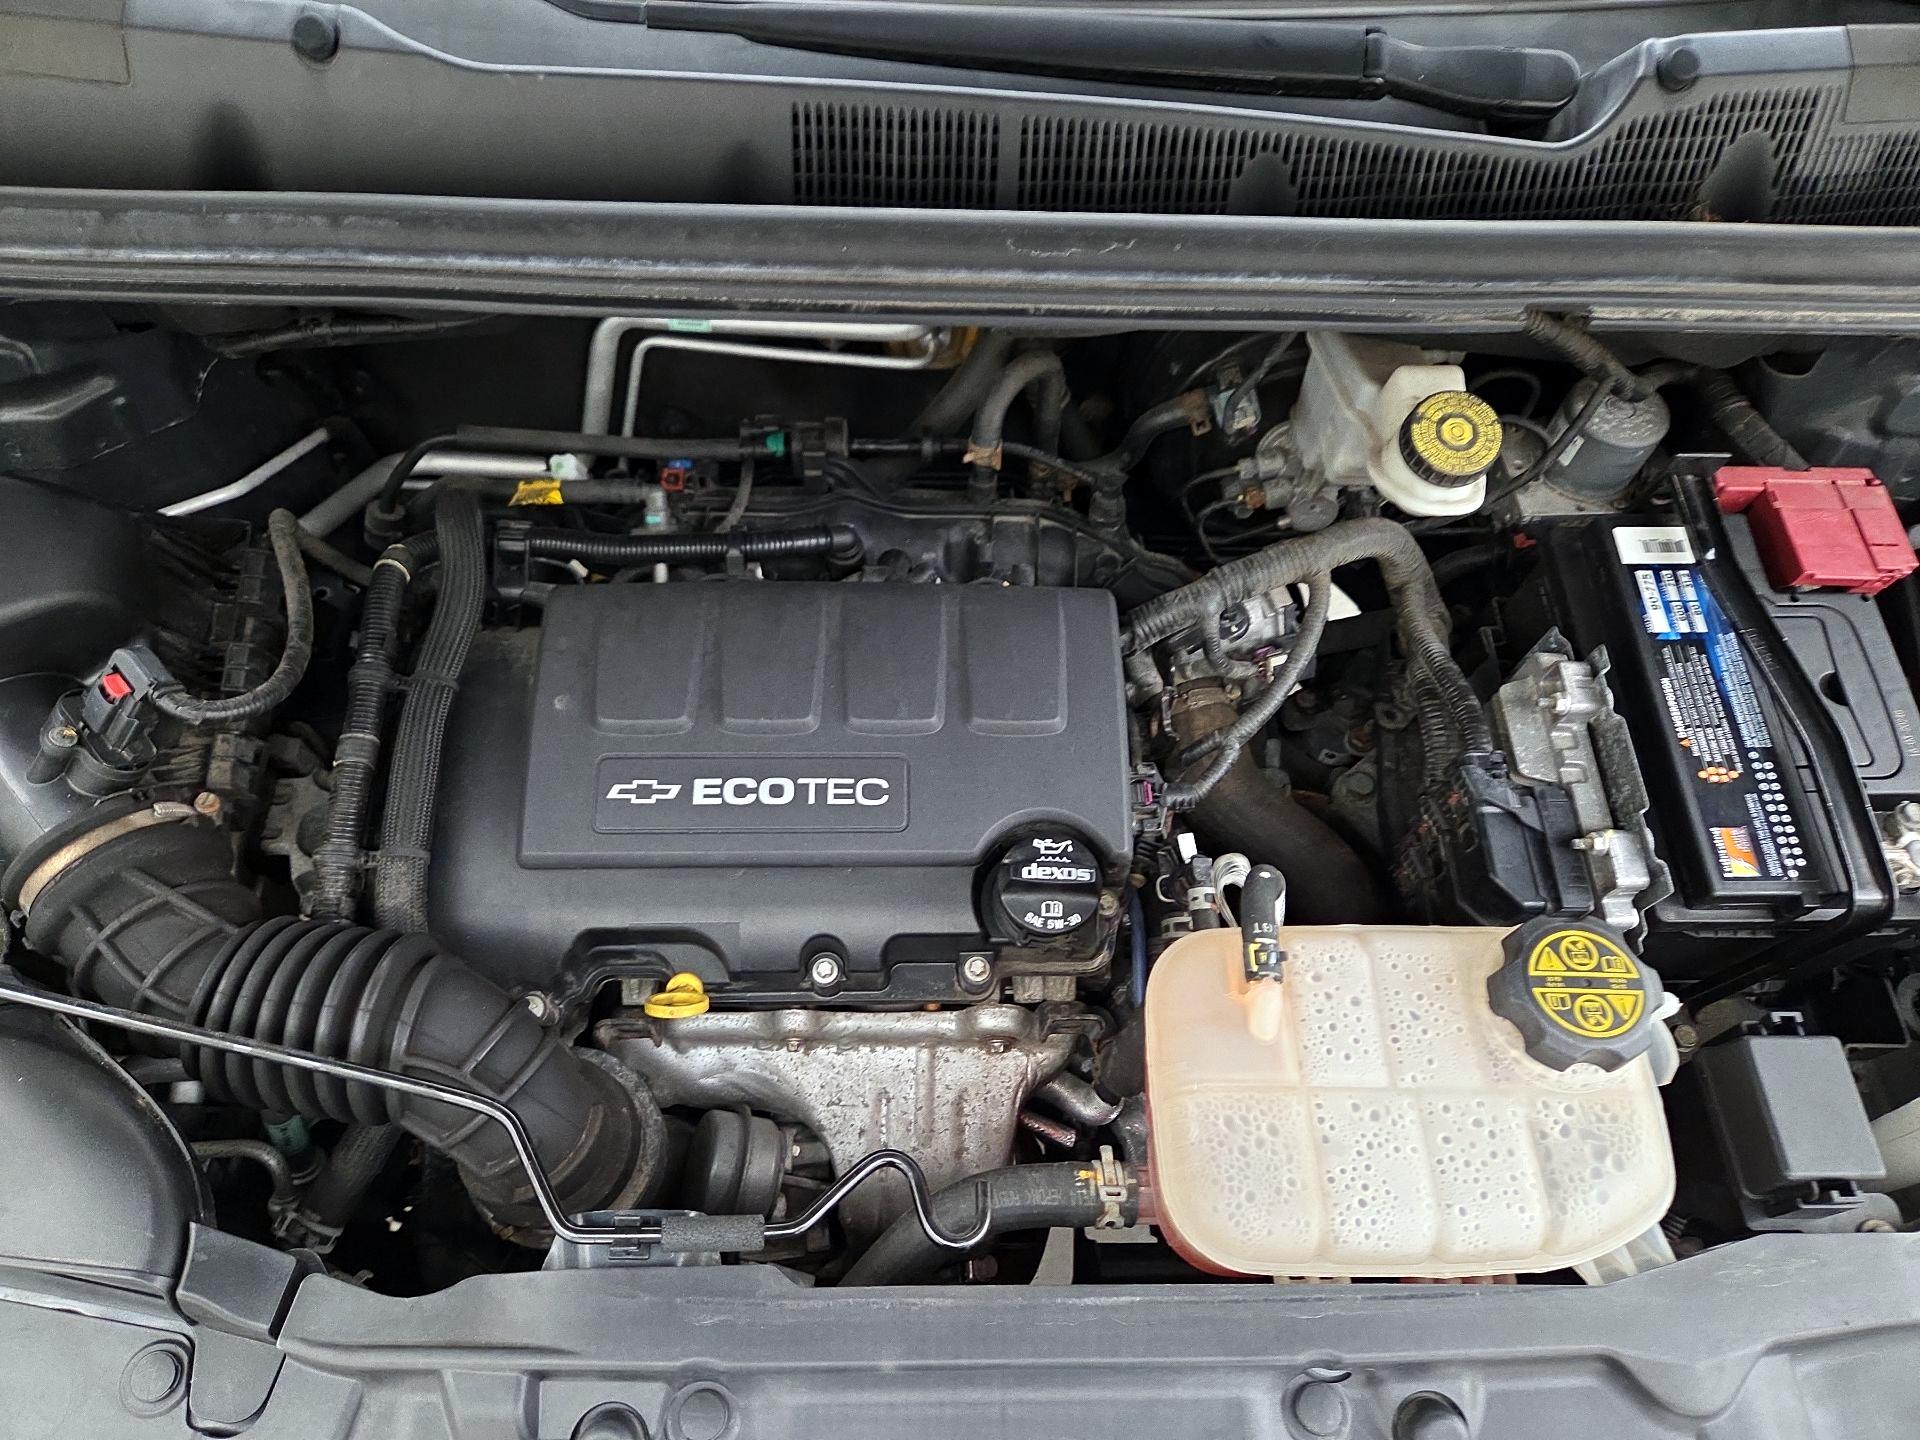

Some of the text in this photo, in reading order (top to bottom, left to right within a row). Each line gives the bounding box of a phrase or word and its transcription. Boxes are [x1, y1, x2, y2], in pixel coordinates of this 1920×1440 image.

[692, 777, 890, 806] ECOTEC
[1021, 863, 1092, 881] dexos
[1024, 911, 1082, 930] SAE 5W-30
